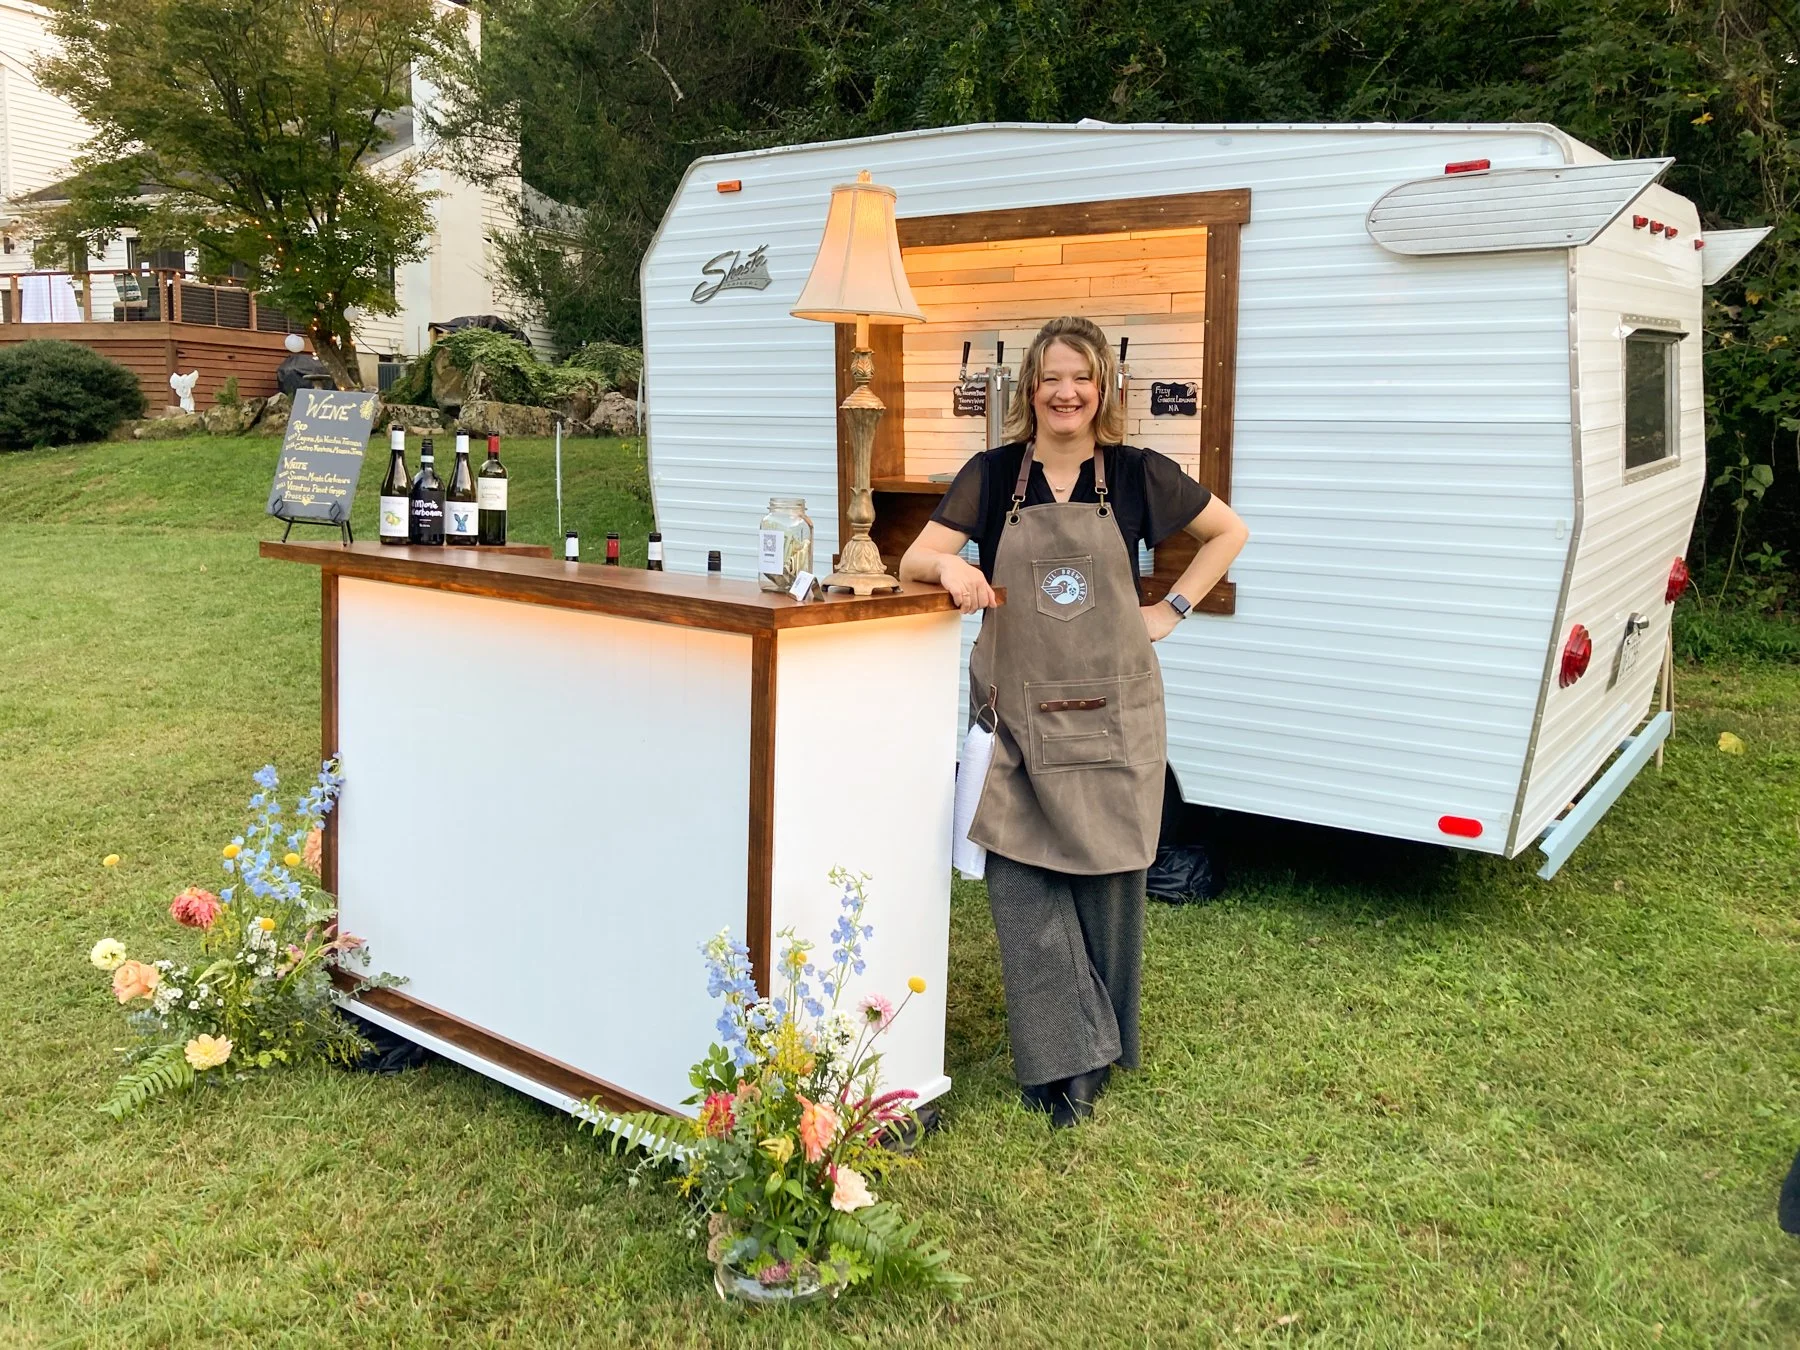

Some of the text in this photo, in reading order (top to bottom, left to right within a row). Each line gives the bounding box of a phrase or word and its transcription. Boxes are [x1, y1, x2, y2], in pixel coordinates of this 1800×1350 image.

[690, 244, 769, 304] Shasta
[306, 393, 357, 421] WINE
[1061, 569, 1081, 580] BREW
